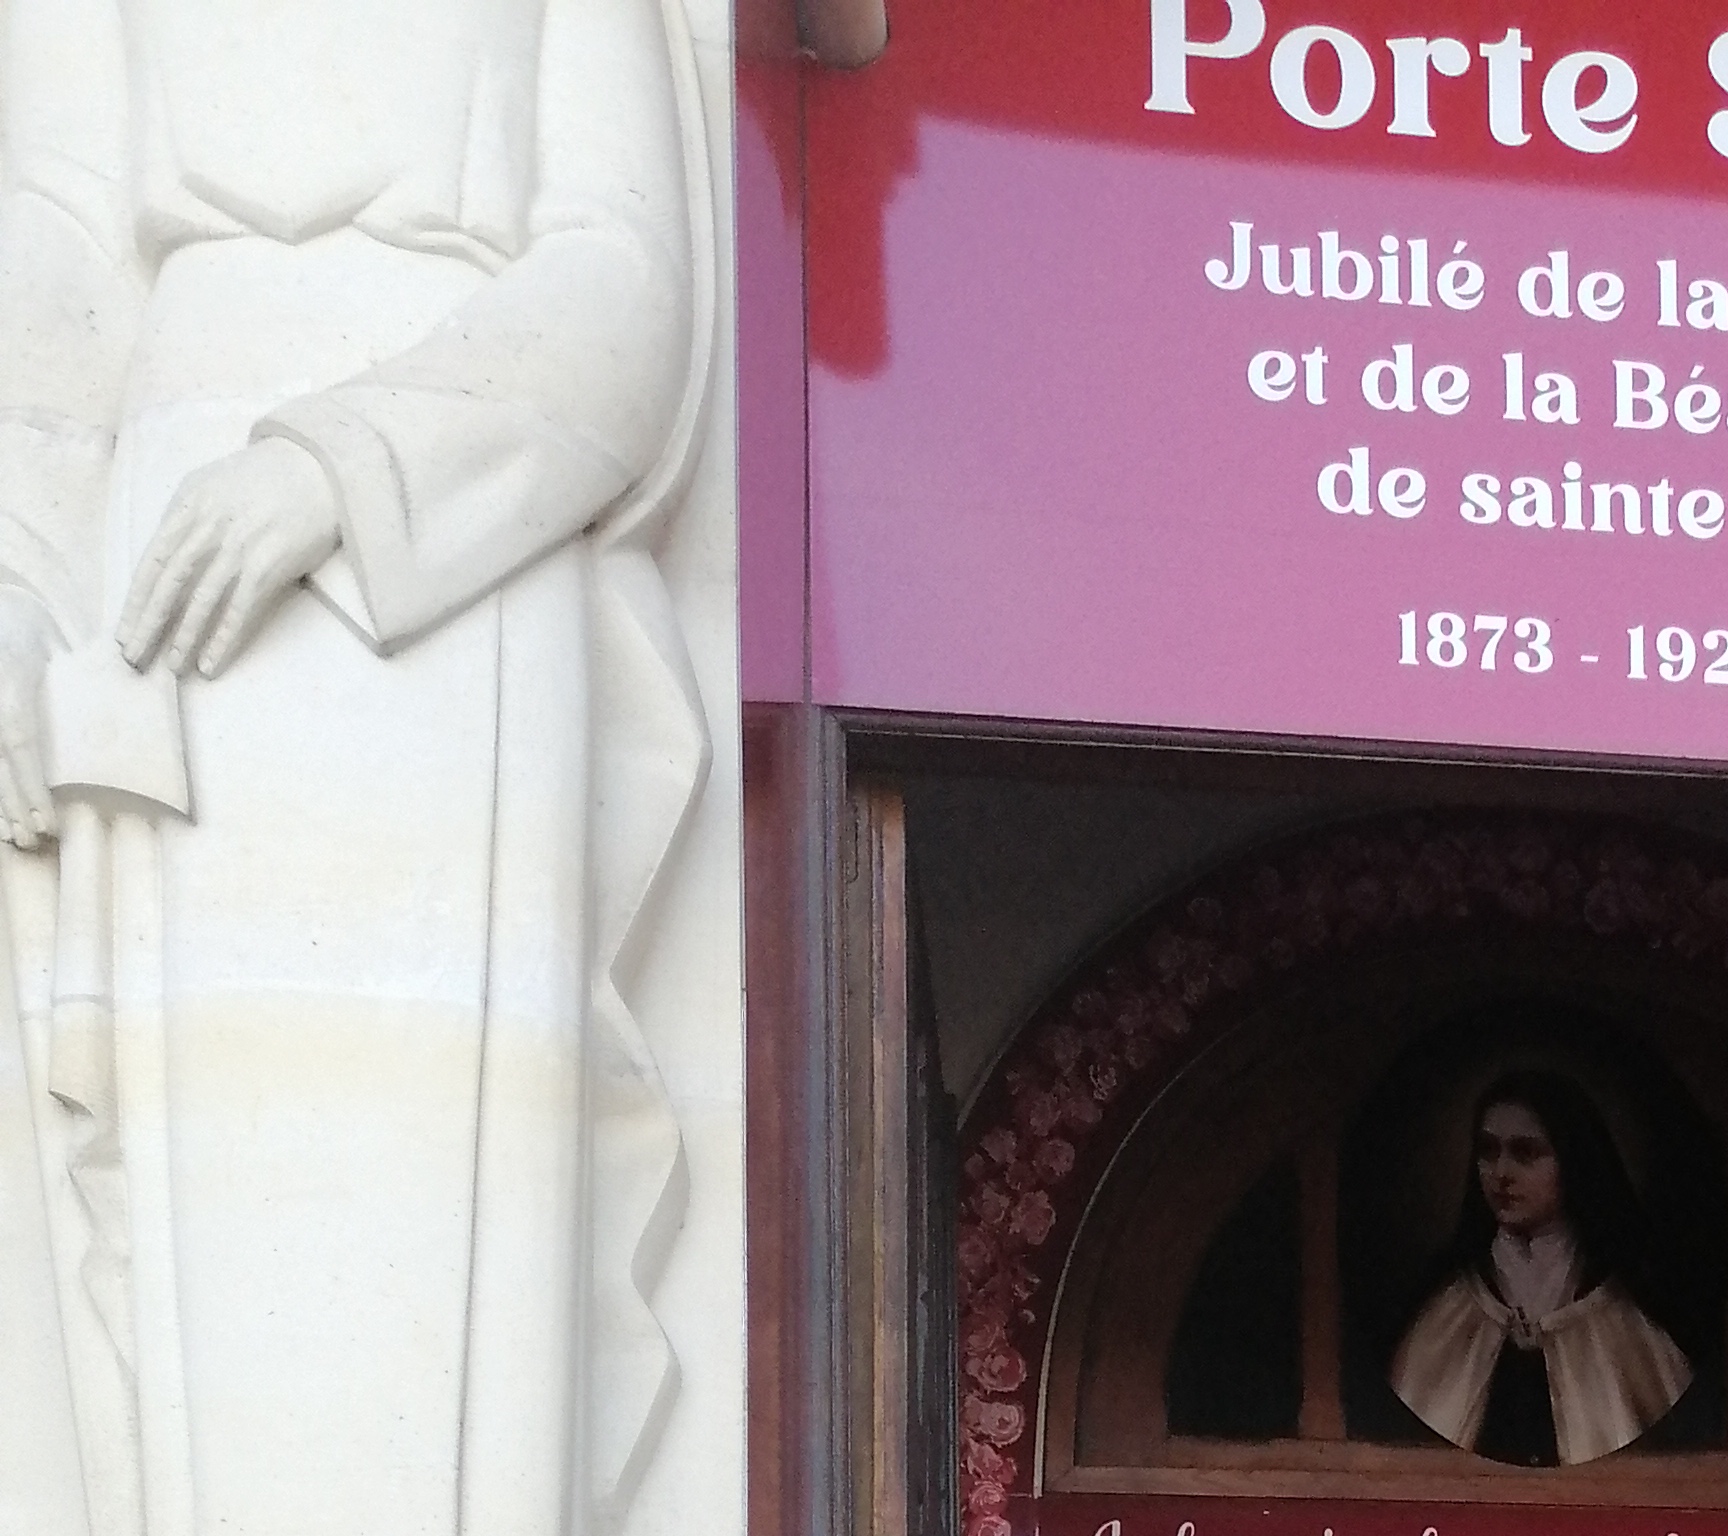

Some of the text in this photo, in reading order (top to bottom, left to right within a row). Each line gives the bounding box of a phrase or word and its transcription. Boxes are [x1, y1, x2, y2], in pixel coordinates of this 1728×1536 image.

[1145, 0, 1637, 152] Porte
[1205, 222, 1484, 310] Jubilé
[1518, 251, 1624, 321] de
[1248, 347, 1328, 405] et
[1362, 344, 1469, 415] de
[1503, 353, 1580, 424] la
[1318, 447, 1426, 518] de
[1460, 461, 1724, 539] sainte
[1399, 611, 1553, 673] 1873
